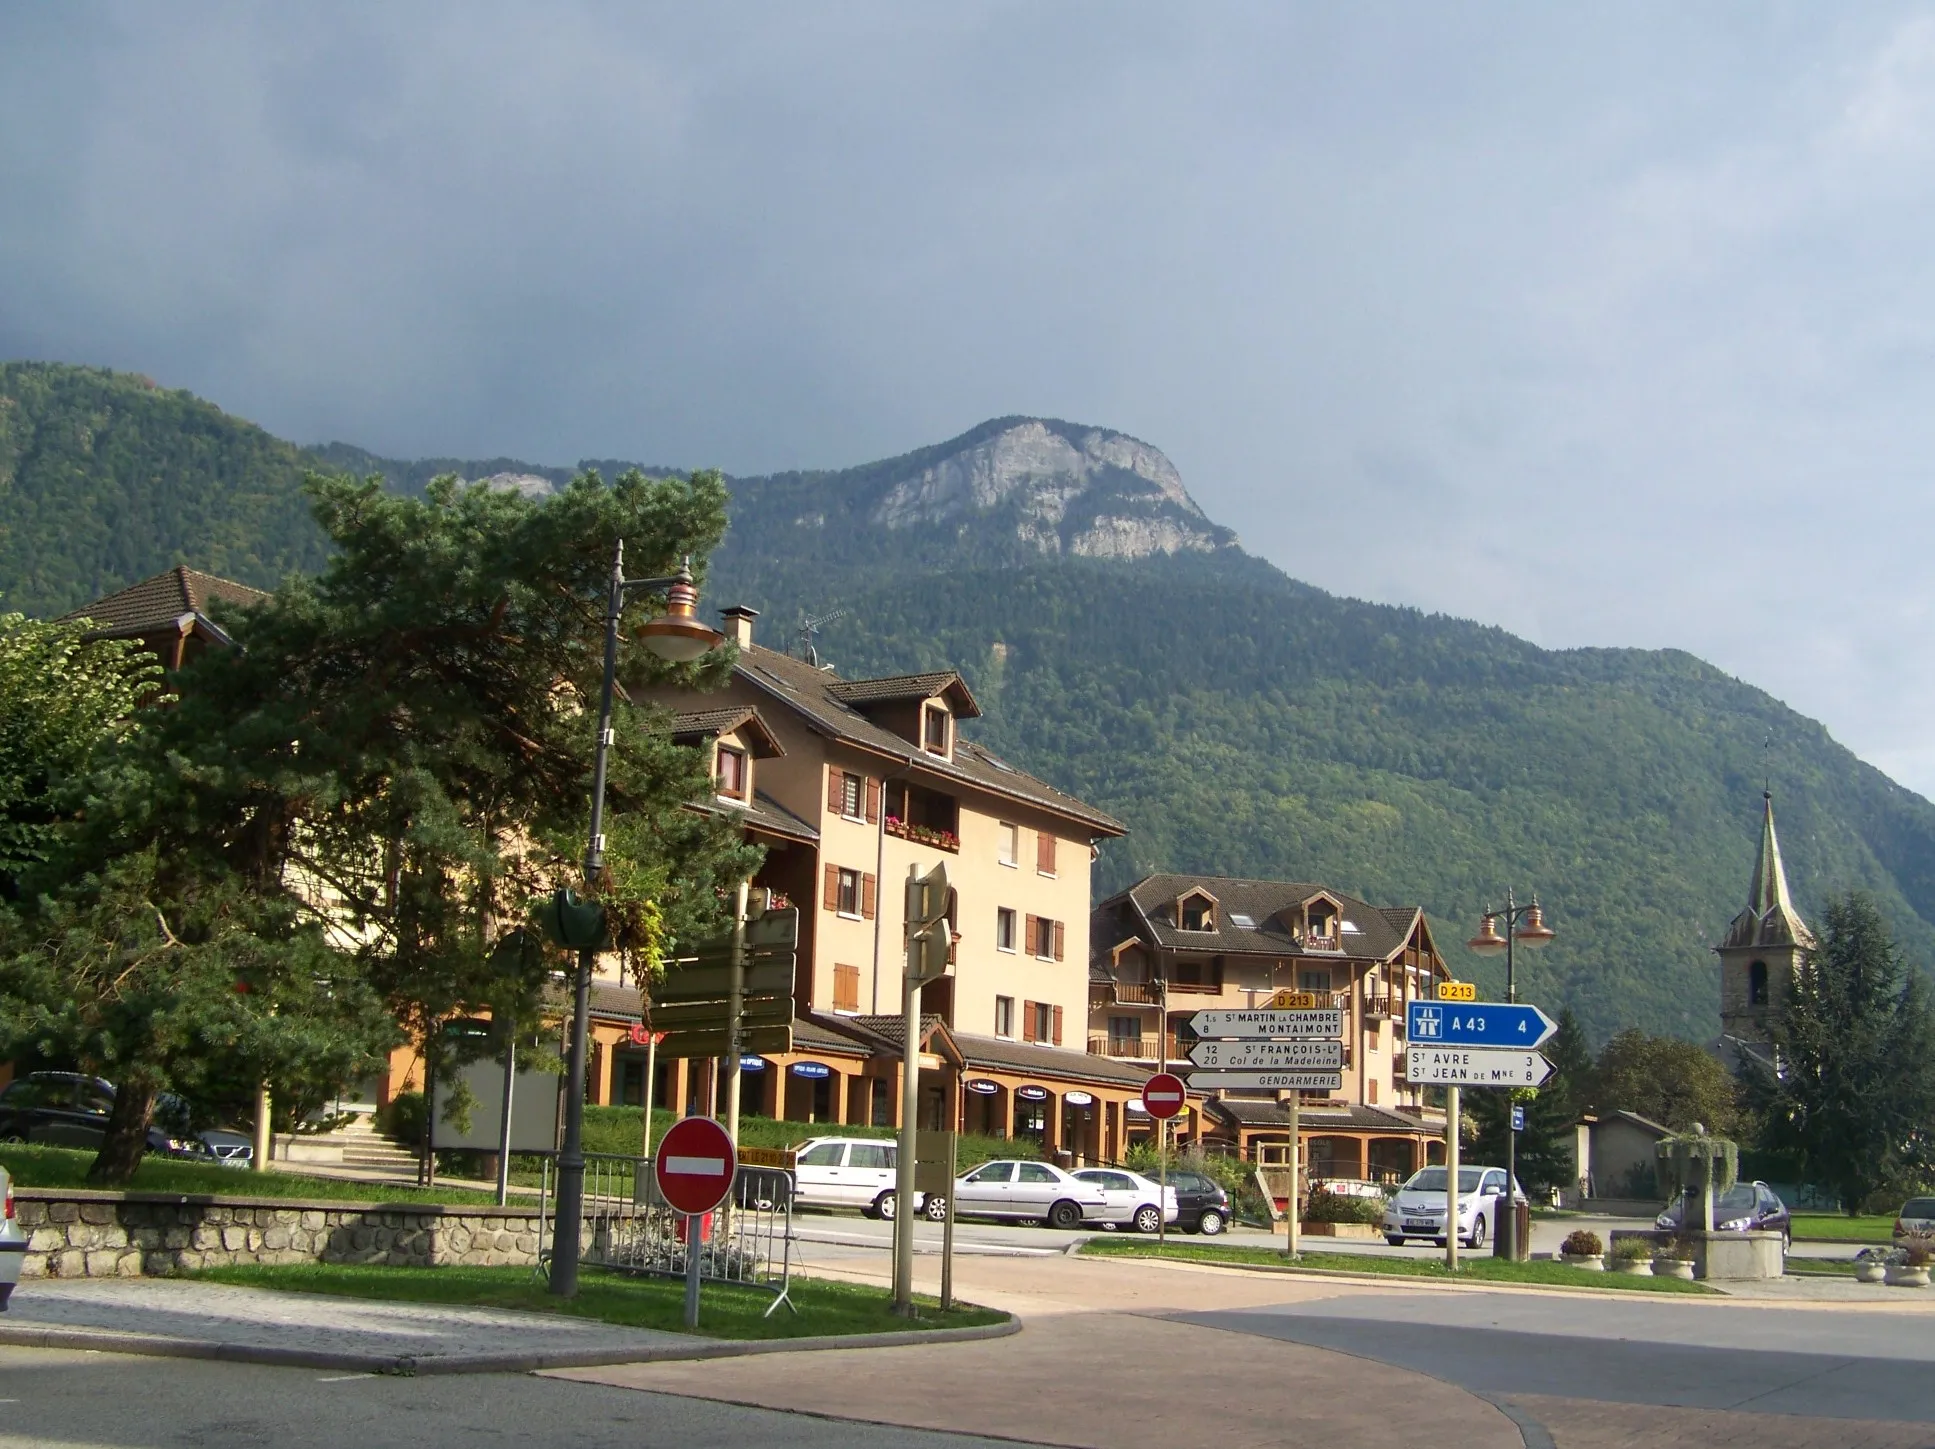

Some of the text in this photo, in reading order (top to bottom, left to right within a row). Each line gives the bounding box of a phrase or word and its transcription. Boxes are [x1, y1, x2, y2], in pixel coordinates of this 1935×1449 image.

[1440, 986, 1472, 997] D 213
[1278, 995, 1309, 1006] D 213
[1238, 1013, 1276, 1022] MARTIN
[1289, 1013, 1339, 1022] CHAMBRE
[1203, 1024, 1339, 1034] 8 MONTAIMONT
[1452, 1017, 1527, 1034] A 43 4
[1206, 1045, 1218, 1054] 12
[1203, 1056, 1338, 1065] 20 Col de la Madeleine
[1433, 1054, 1470, 1065] AVRE
[1526, 1056, 1533, 1067] 3
[1432, 1068, 1468, 1079] JEAN
[1473, 1072, 1486, 1080] DE
[1525, 1071, 1533, 1082] 8
[1259, 1076, 1338, 1085] GENDARMERIE
